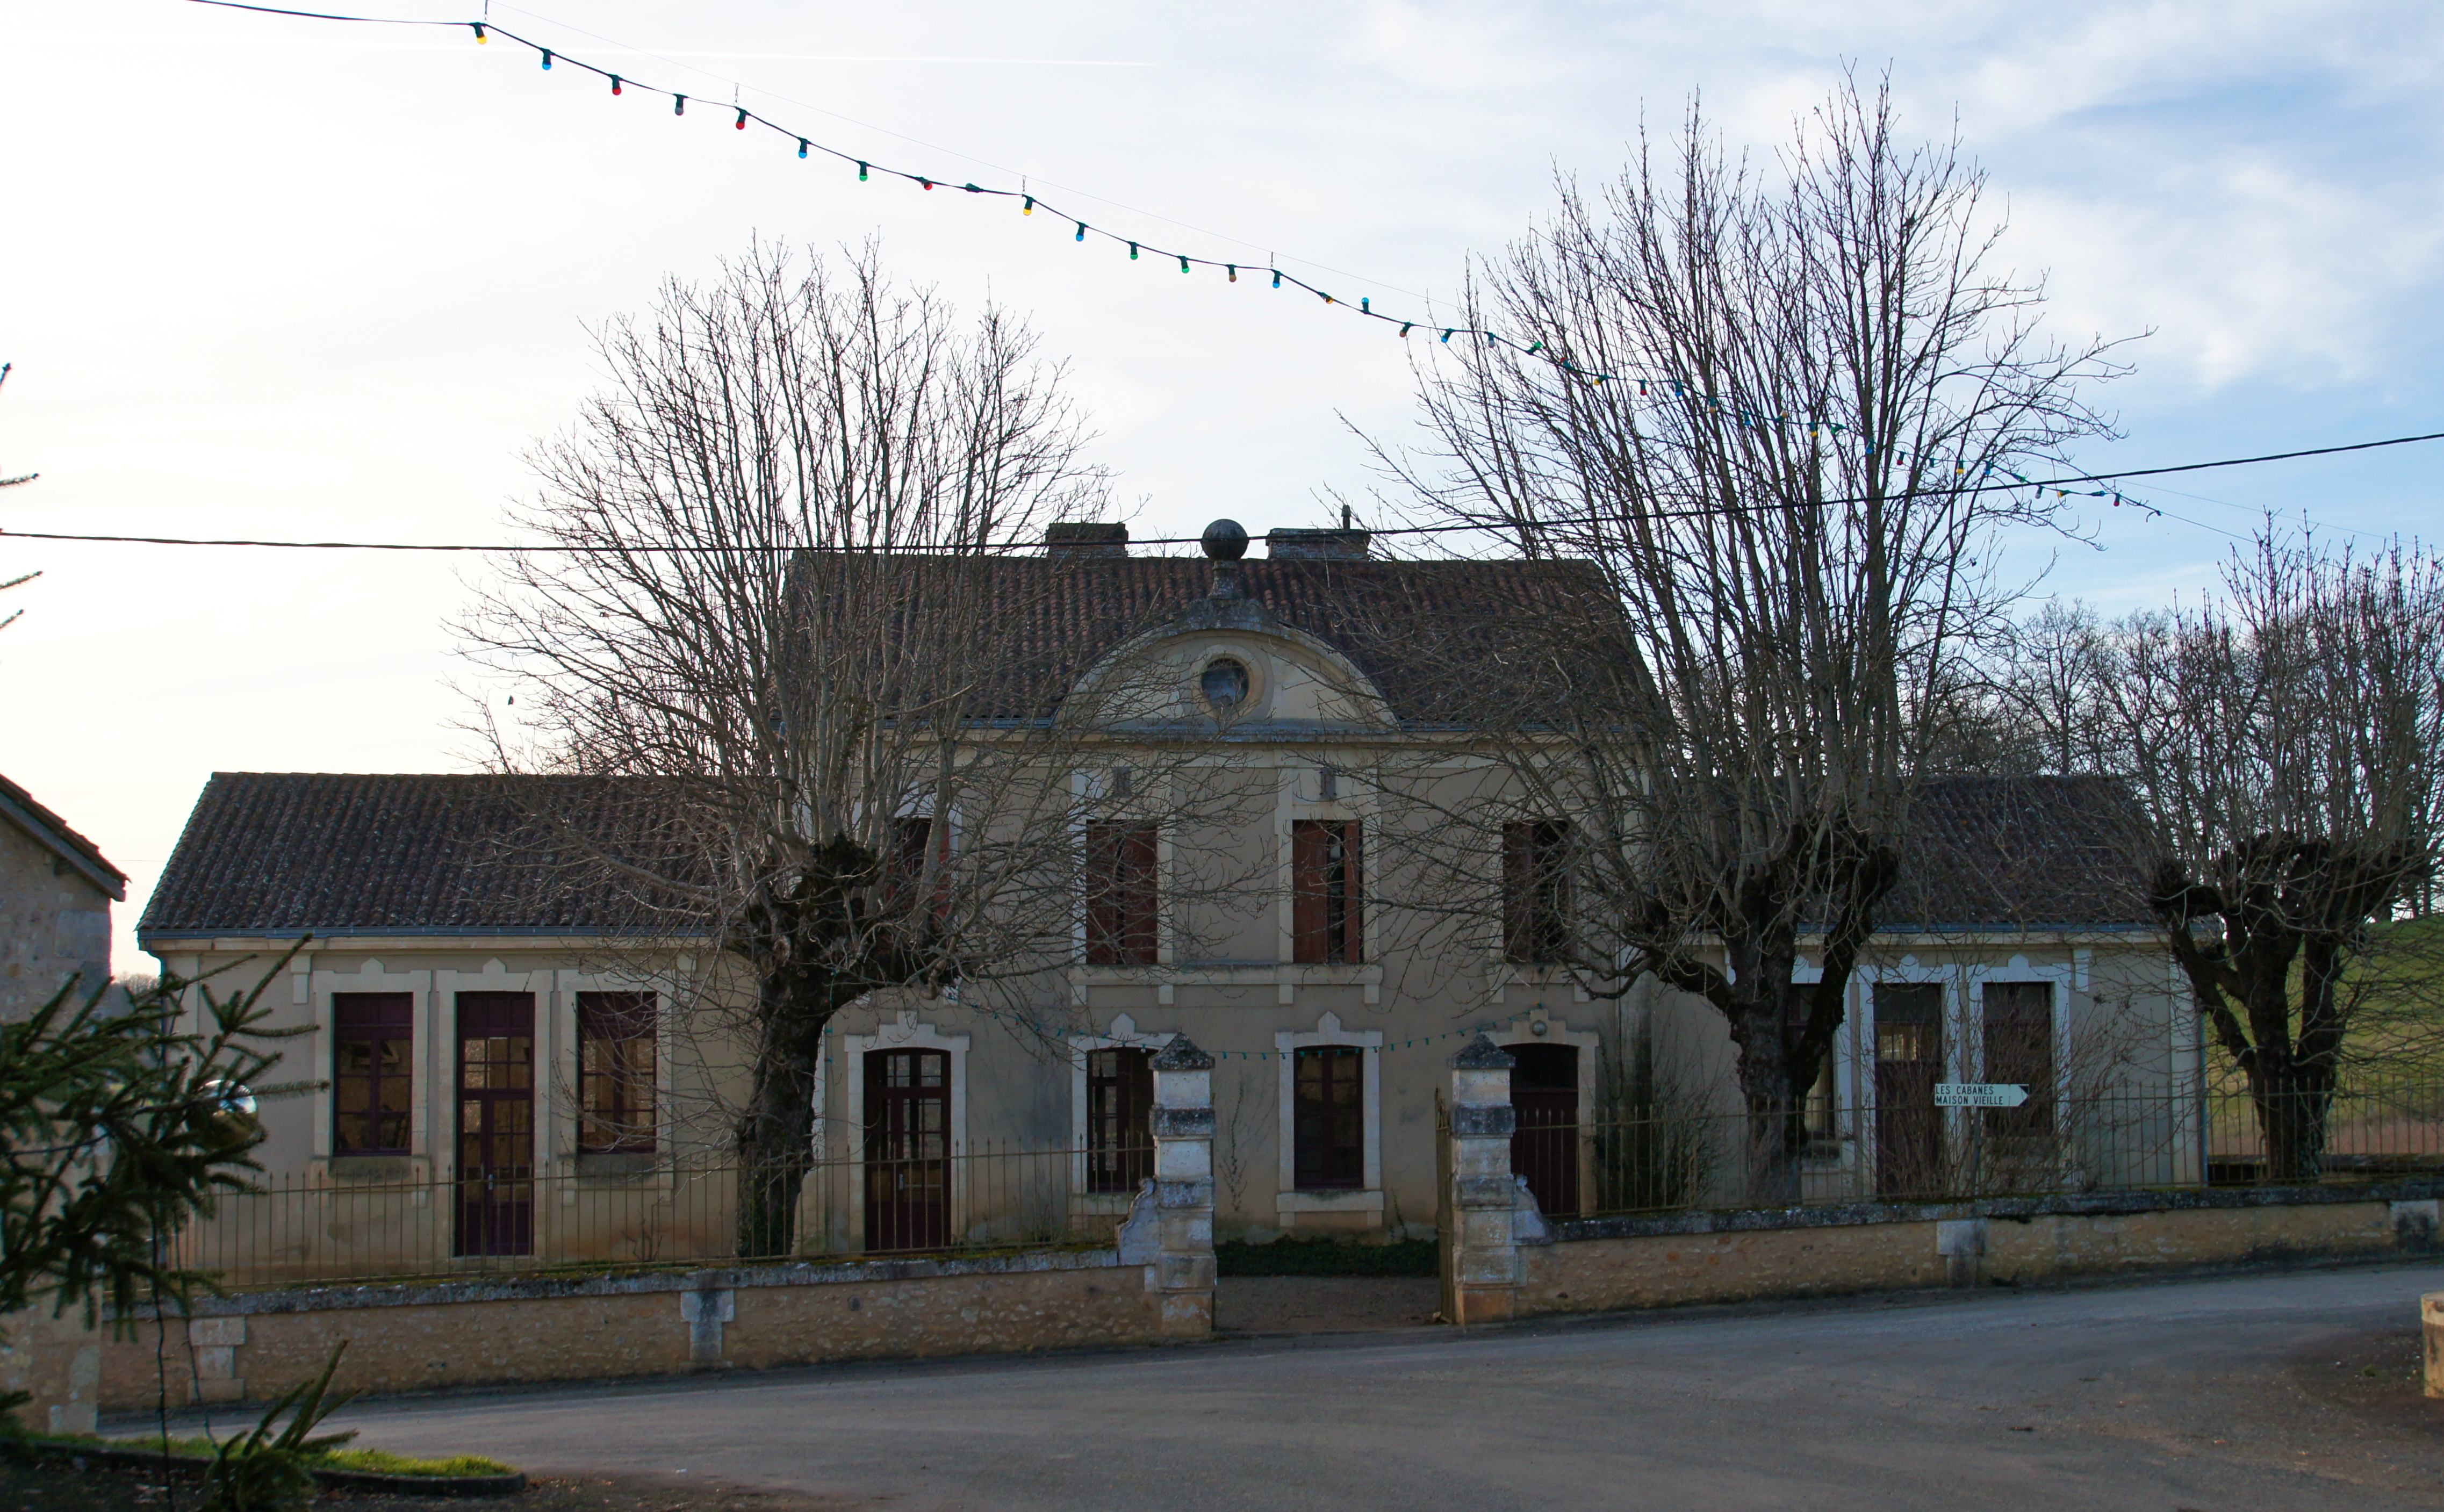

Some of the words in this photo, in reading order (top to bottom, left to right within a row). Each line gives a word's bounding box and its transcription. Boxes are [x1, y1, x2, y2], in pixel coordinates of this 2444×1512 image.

[1936, 1085, 1950, 1094] LES
[1957, 1085, 1994, 1095] CABANES
[1936, 1096, 1968, 1104] MAISON
[1974, 1096, 2003, 1105] VIEILLE
